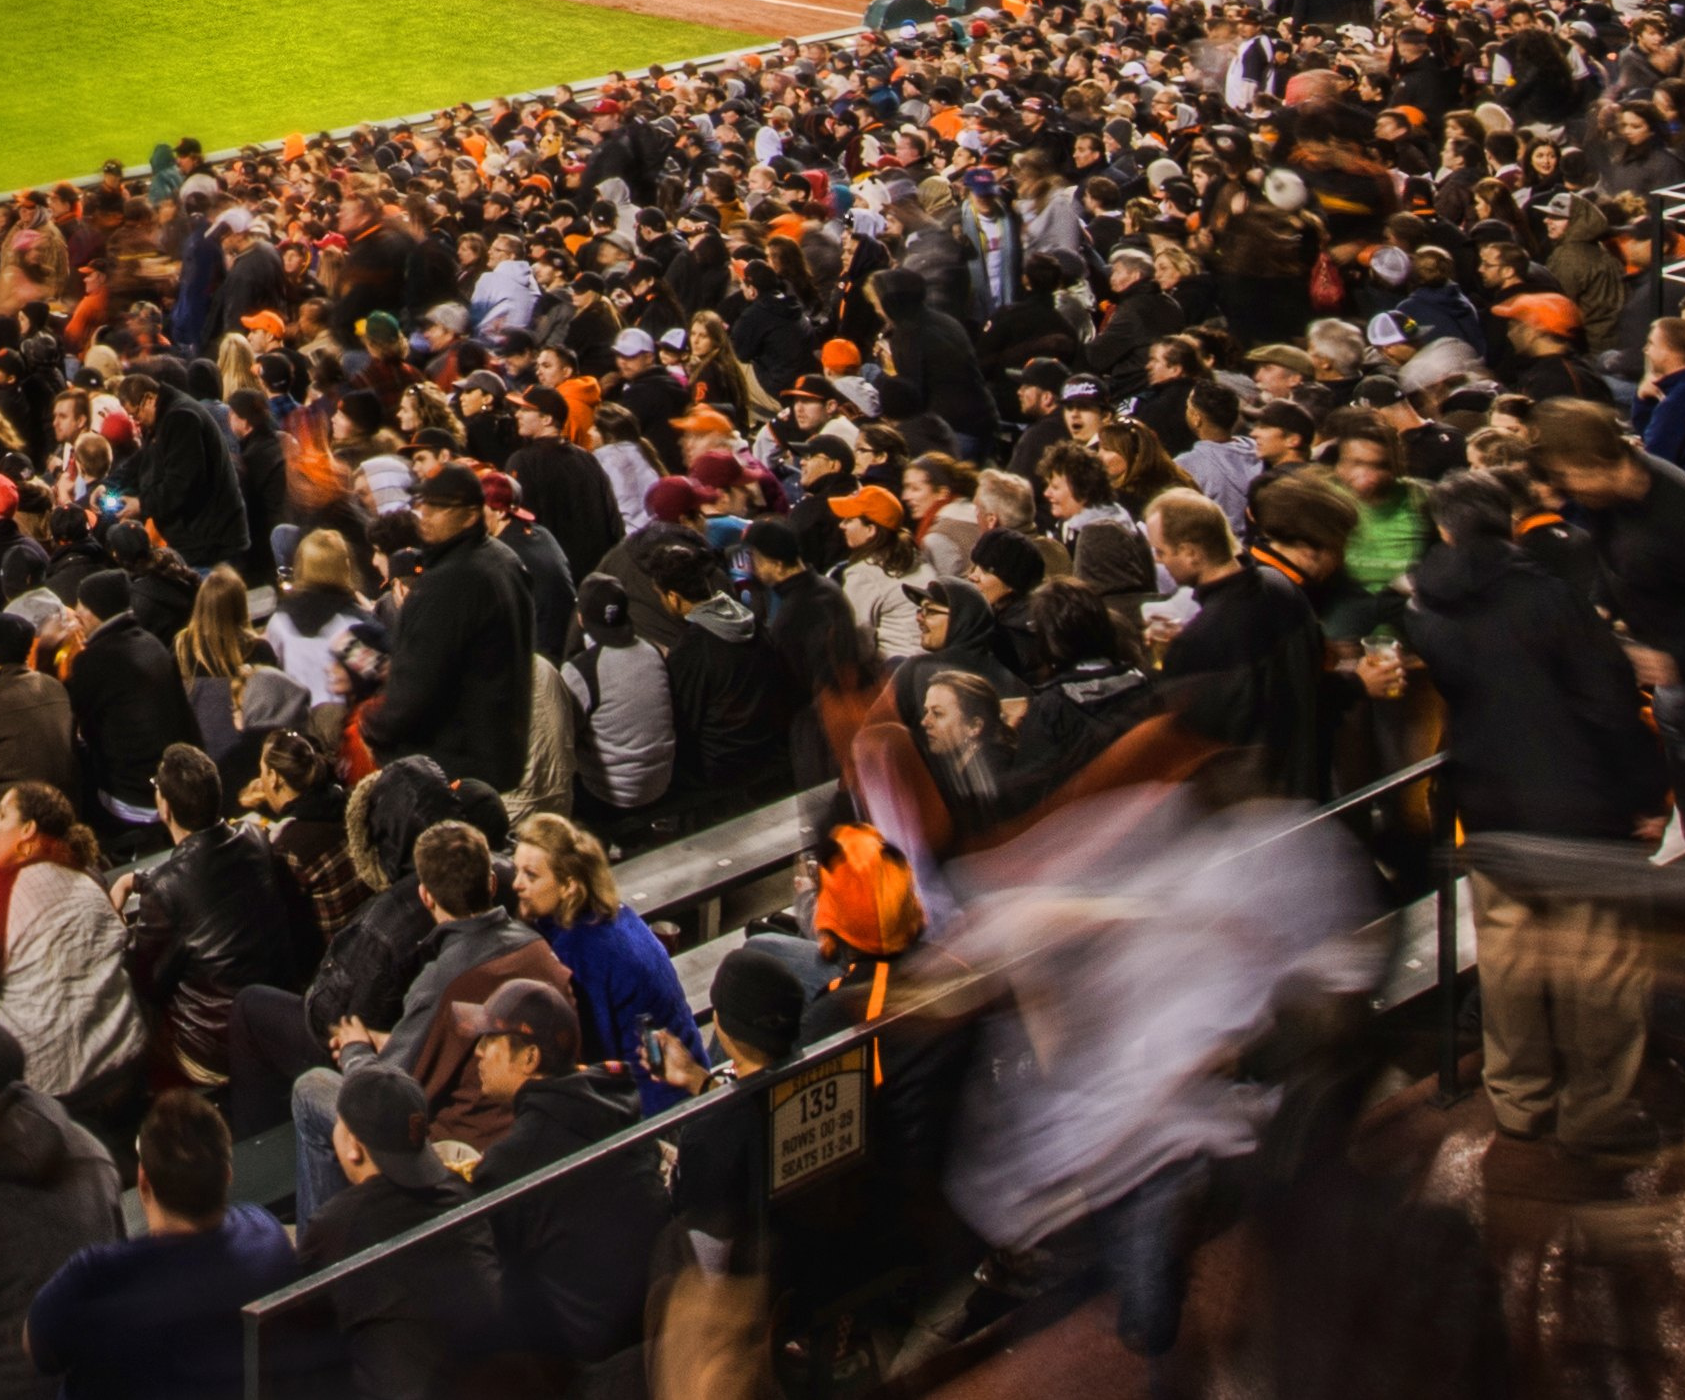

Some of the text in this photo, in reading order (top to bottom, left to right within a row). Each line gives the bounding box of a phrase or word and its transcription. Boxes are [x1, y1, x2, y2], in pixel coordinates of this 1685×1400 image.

[800, 1079, 837, 1124] 139
[781, 1127, 816, 1158] ROWS
[781, 1149, 818, 1180] SEATS
